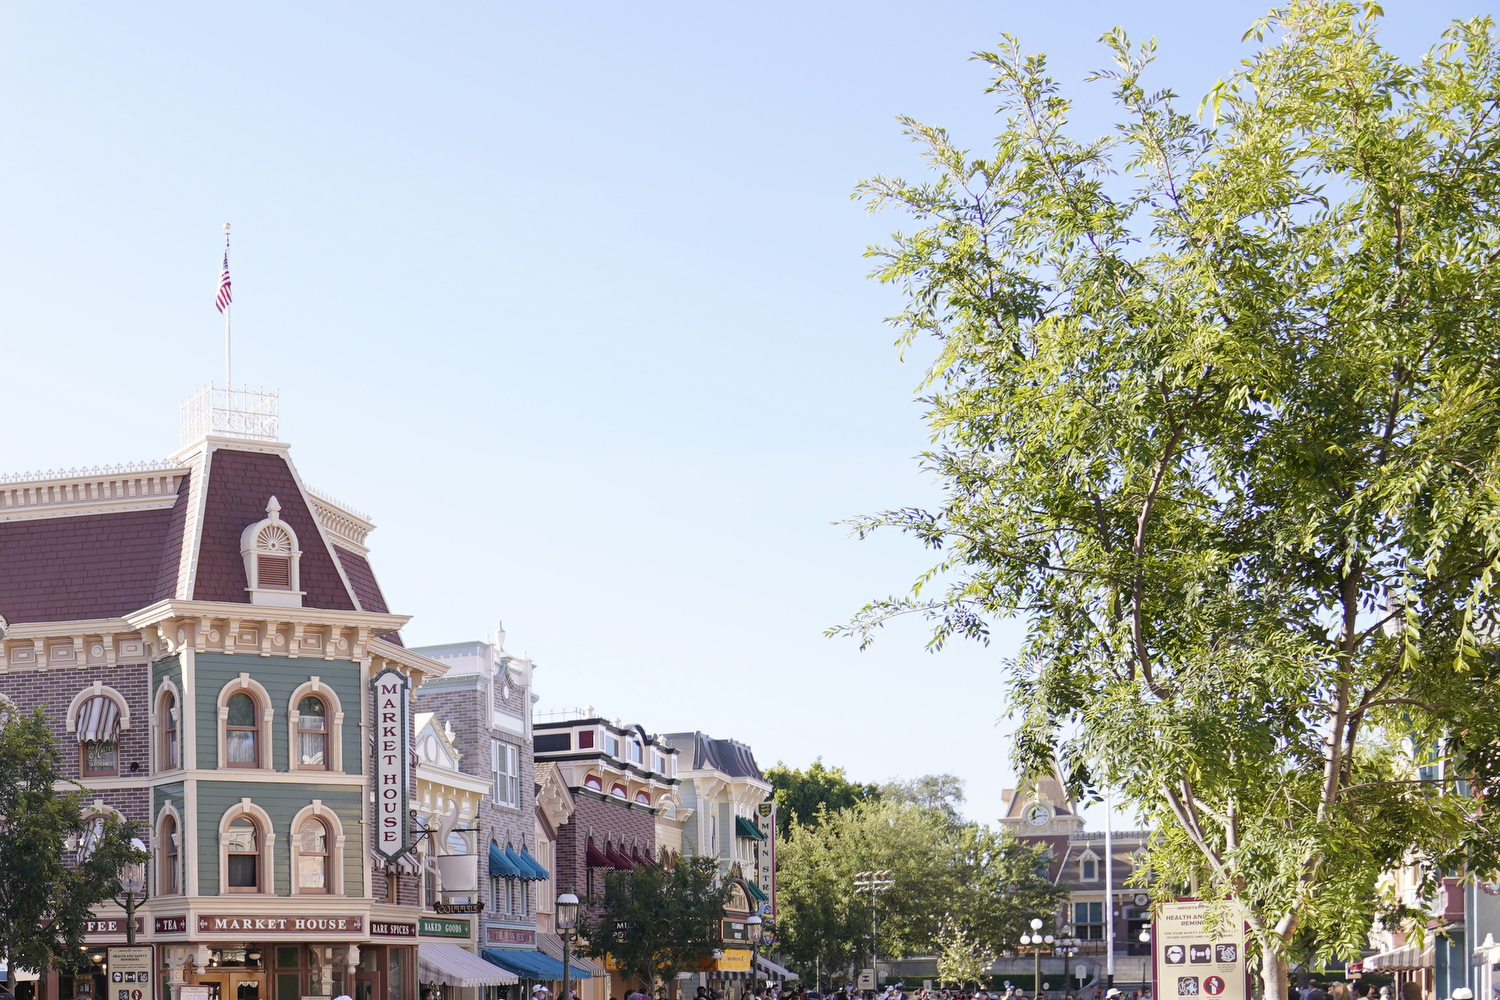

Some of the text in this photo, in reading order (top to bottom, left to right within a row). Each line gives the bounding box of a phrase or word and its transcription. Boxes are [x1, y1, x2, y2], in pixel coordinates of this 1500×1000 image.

[381, 683, 398, 842] MARKET HOUSE
[163, 919, 177, 930] TEA
[214, 918, 347, 930] MARKET HOUSE
[372, 923, 410, 935] RARE SPICES
[424, 922, 462, 933] BAKED GOODS
